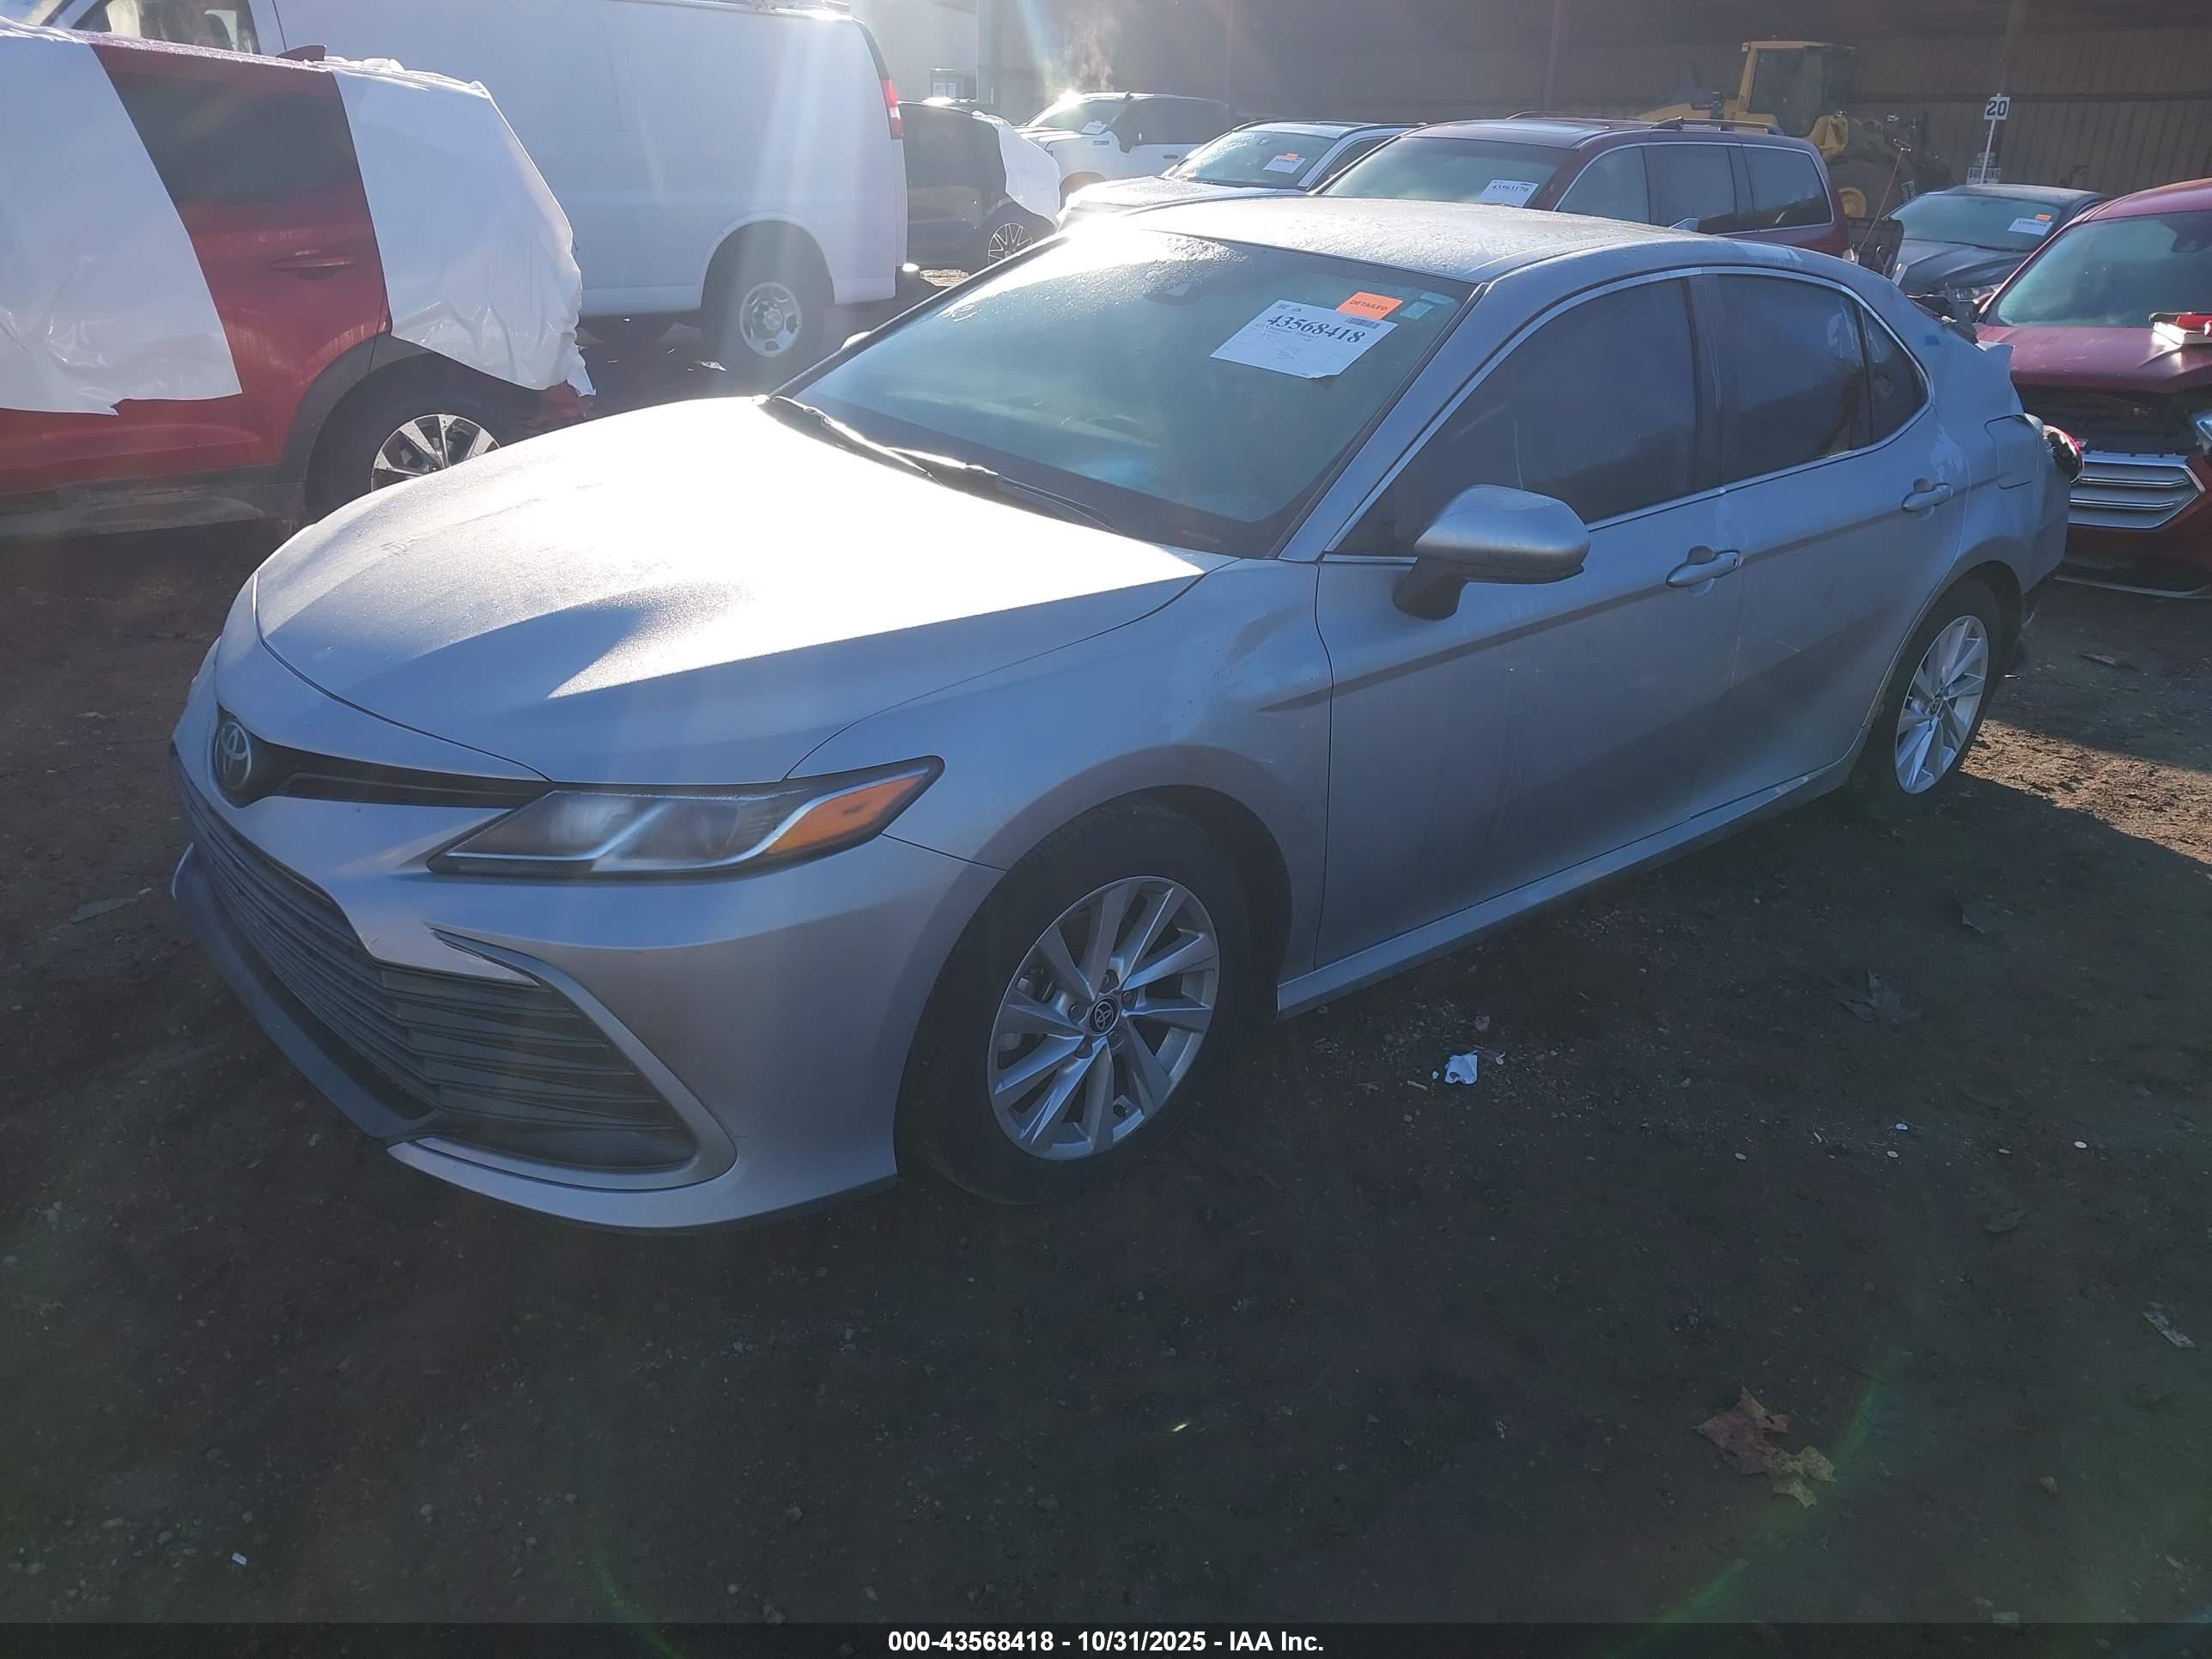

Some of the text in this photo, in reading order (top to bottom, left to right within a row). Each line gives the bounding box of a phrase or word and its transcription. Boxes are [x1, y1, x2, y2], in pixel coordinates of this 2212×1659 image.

[1986, 100, 2008, 117] 20
[1968, 168, 2000, 179] BUIDING
[1349, 299, 1389, 312] DETAILED
[1266, 314, 1366, 344] 43568418
